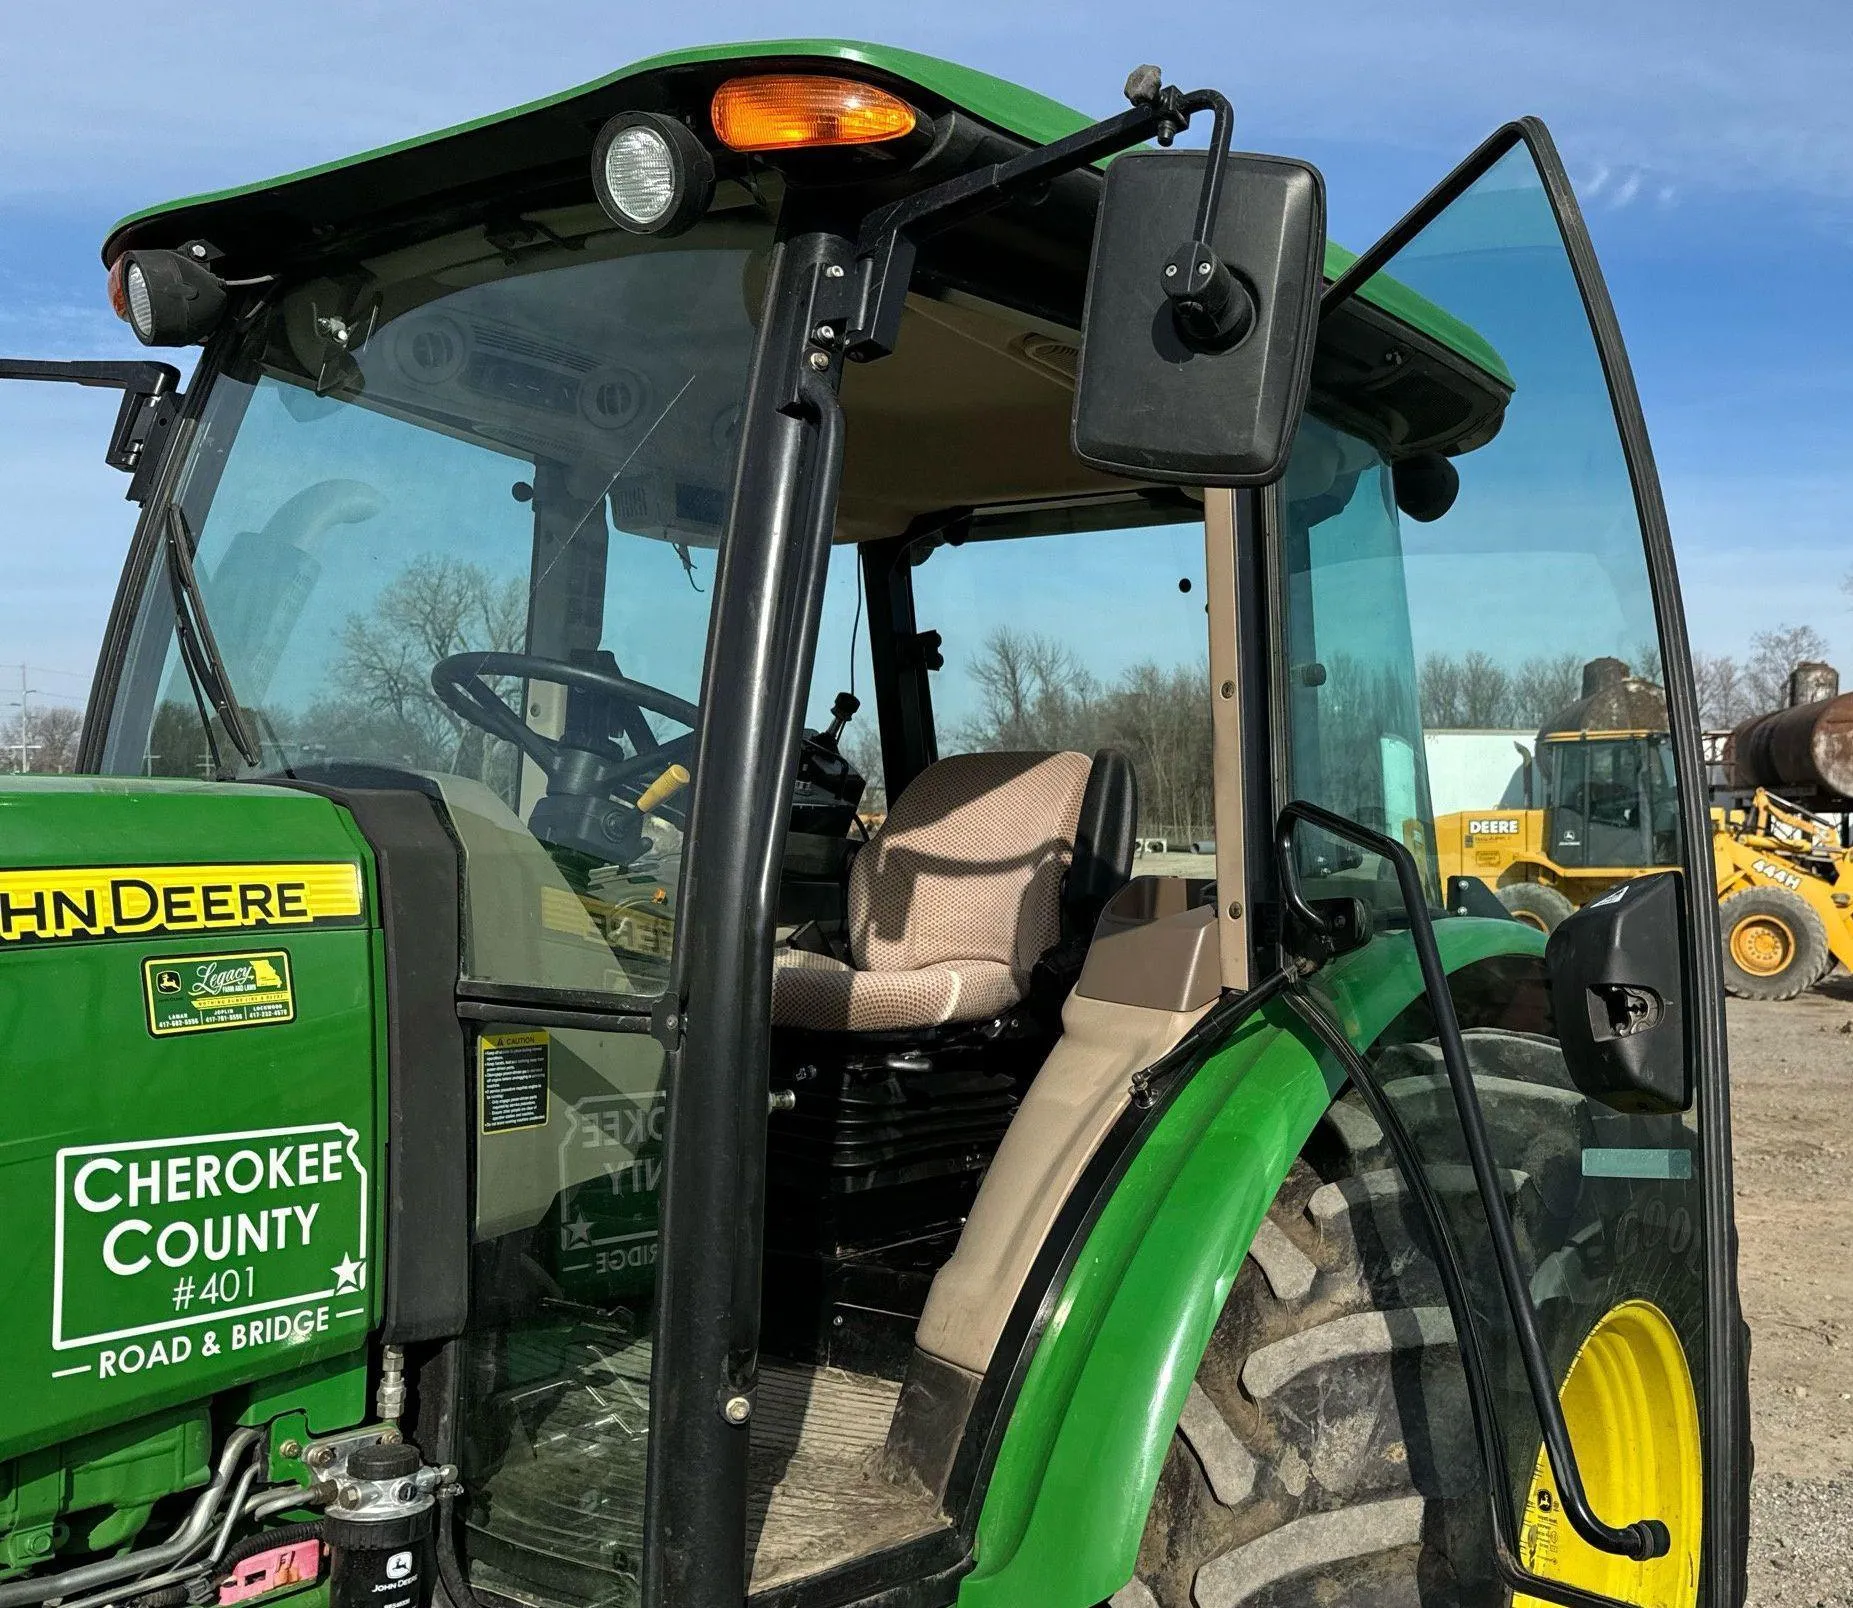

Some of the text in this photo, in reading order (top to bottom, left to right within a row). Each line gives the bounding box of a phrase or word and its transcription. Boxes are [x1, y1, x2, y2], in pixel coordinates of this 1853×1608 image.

[1469, 819, 1519, 834] DEERE
[1751, 859, 1801, 891] 444H
[111, 879, 309, 927] DEERE
[188, 961, 255, 995] Legacy
[506, 1036, 536, 1046] CAUTION
[73, 1140, 342, 1213] CHEROKEE
[102, 1202, 320, 1276] COUNTY
[172, 1266, 255, 1311] #401
[99, 1306, 330, 1379] ROAD & BRIDGE
[371, 1582, 397, 1593] JOHN
